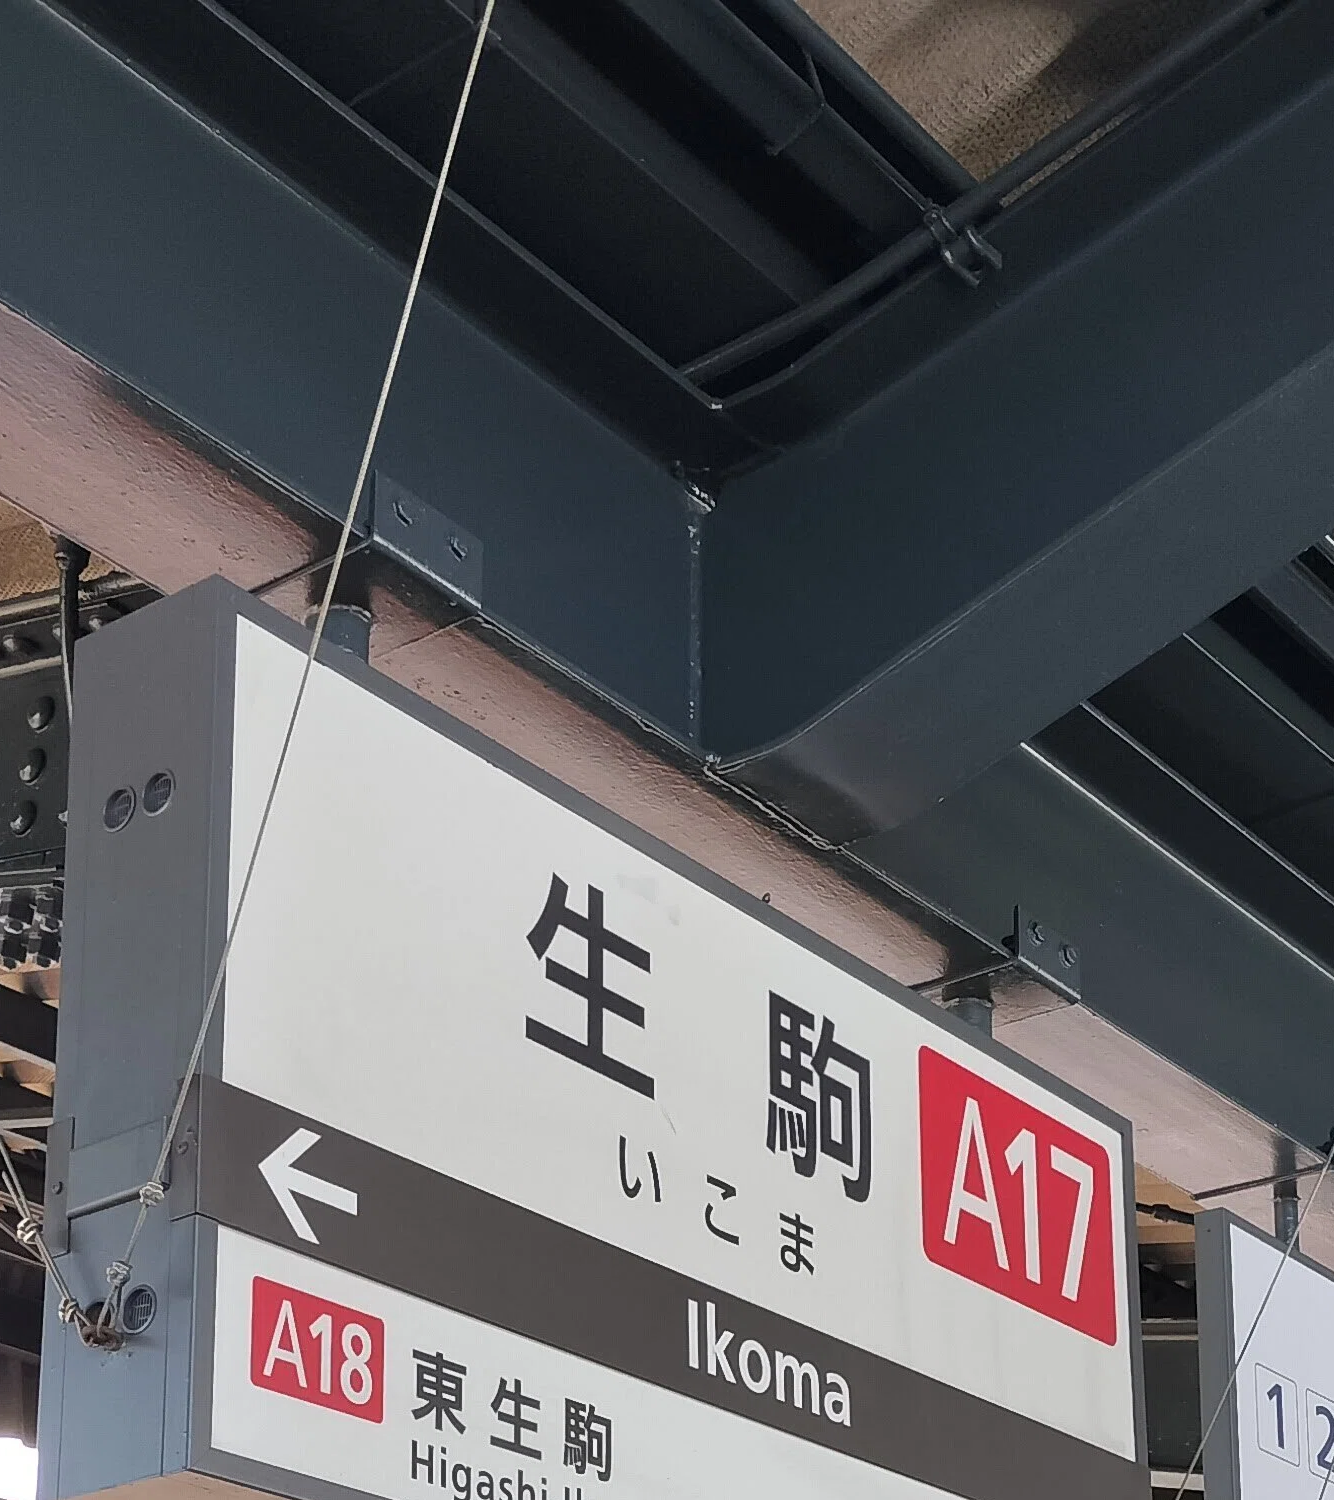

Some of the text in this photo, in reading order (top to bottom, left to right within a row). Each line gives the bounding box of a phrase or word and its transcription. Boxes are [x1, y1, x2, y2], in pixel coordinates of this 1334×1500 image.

[525, 871, 872, 1203] 生駒
[619, 1135, 816, 1276] いこま
[943, 1096, 1093, 1302] A17
[262, 1297, 373, 1405] A18
[411, 1347, 612, 1480] 東生駒
[687, 1298, 851, 1427] Ikoma
[1267, 1383, 1284, 1449] 1
